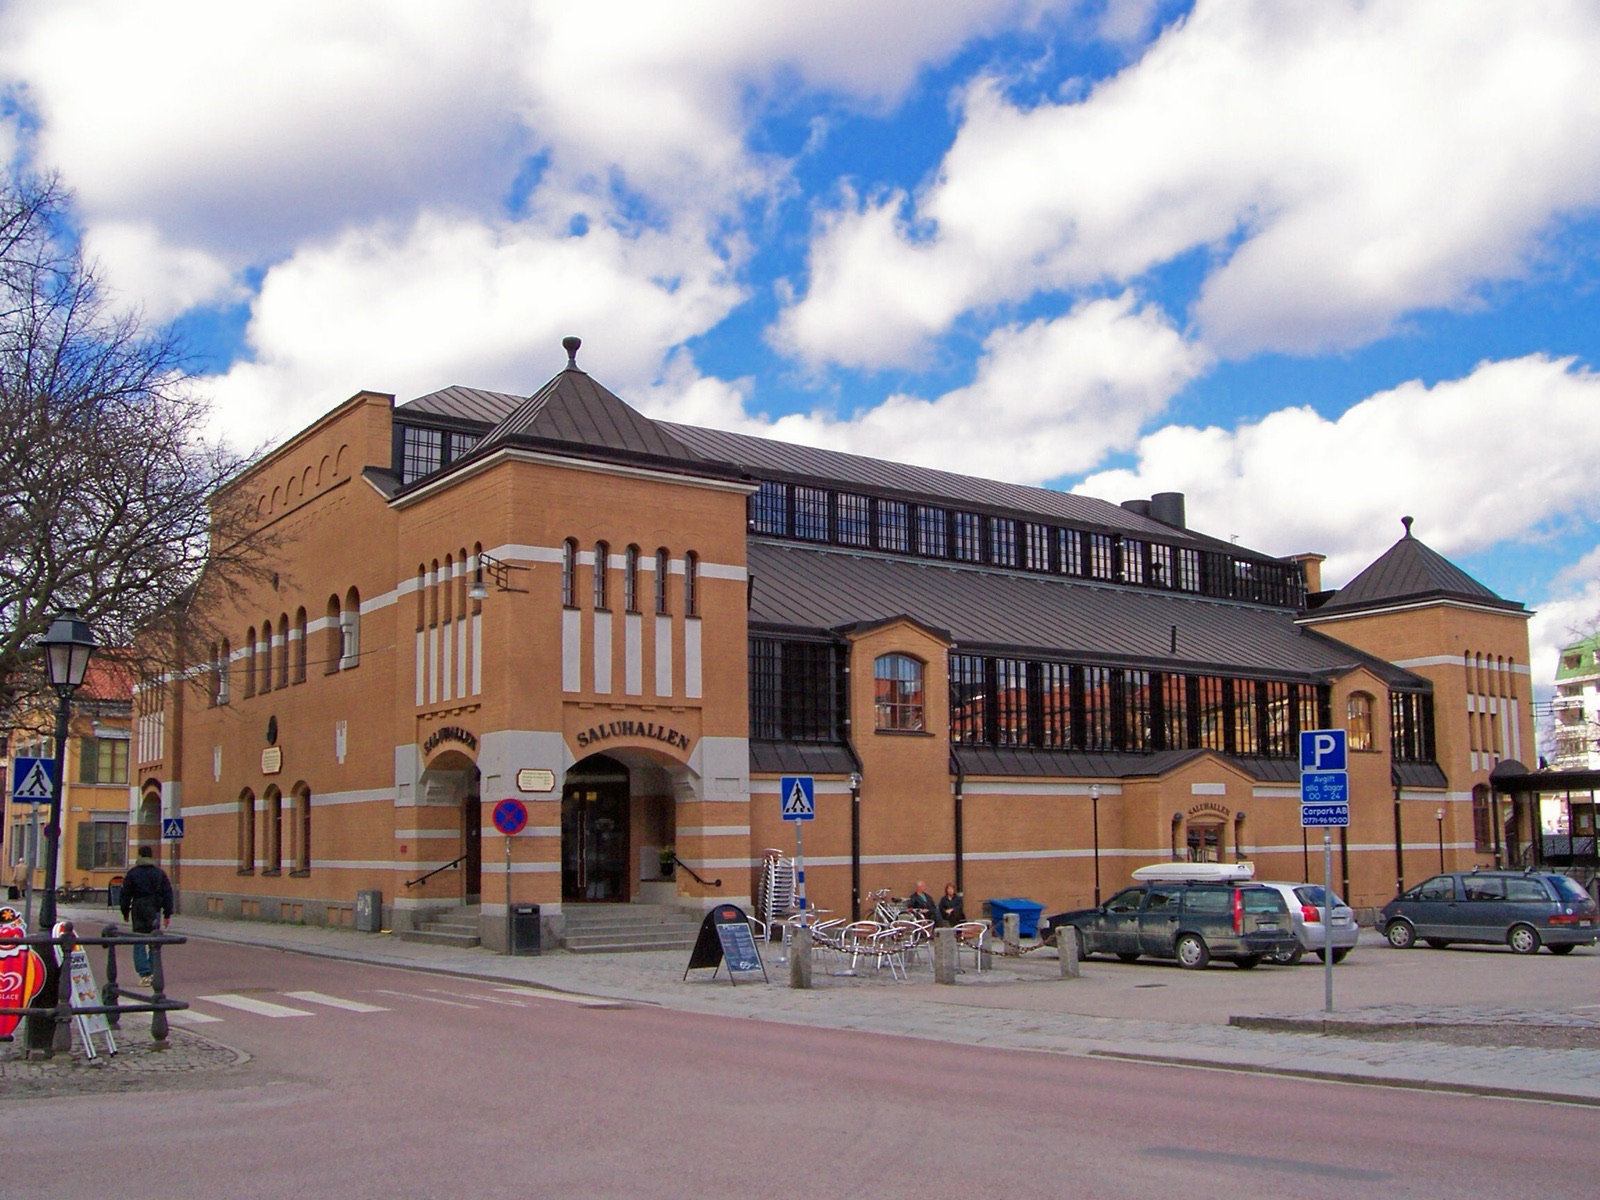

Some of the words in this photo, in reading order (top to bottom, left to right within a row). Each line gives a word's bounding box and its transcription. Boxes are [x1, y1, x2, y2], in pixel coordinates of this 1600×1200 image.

[577, 721, 691, 751] SALUHALLEN
[1315, 735, 1336, 767] P
[1313, 776, 1335, 784] Avgift
[1322, 785, 1344, 793] dagar
[1309, 792, 1321, 800] 00
[1330, 791, 1341, 800] 24
[1188, 803, 1230, 816] SALUHALLEN
[1303, 807, 1334, 816] Carpark
[1335, 806, 1348, 815] AB
